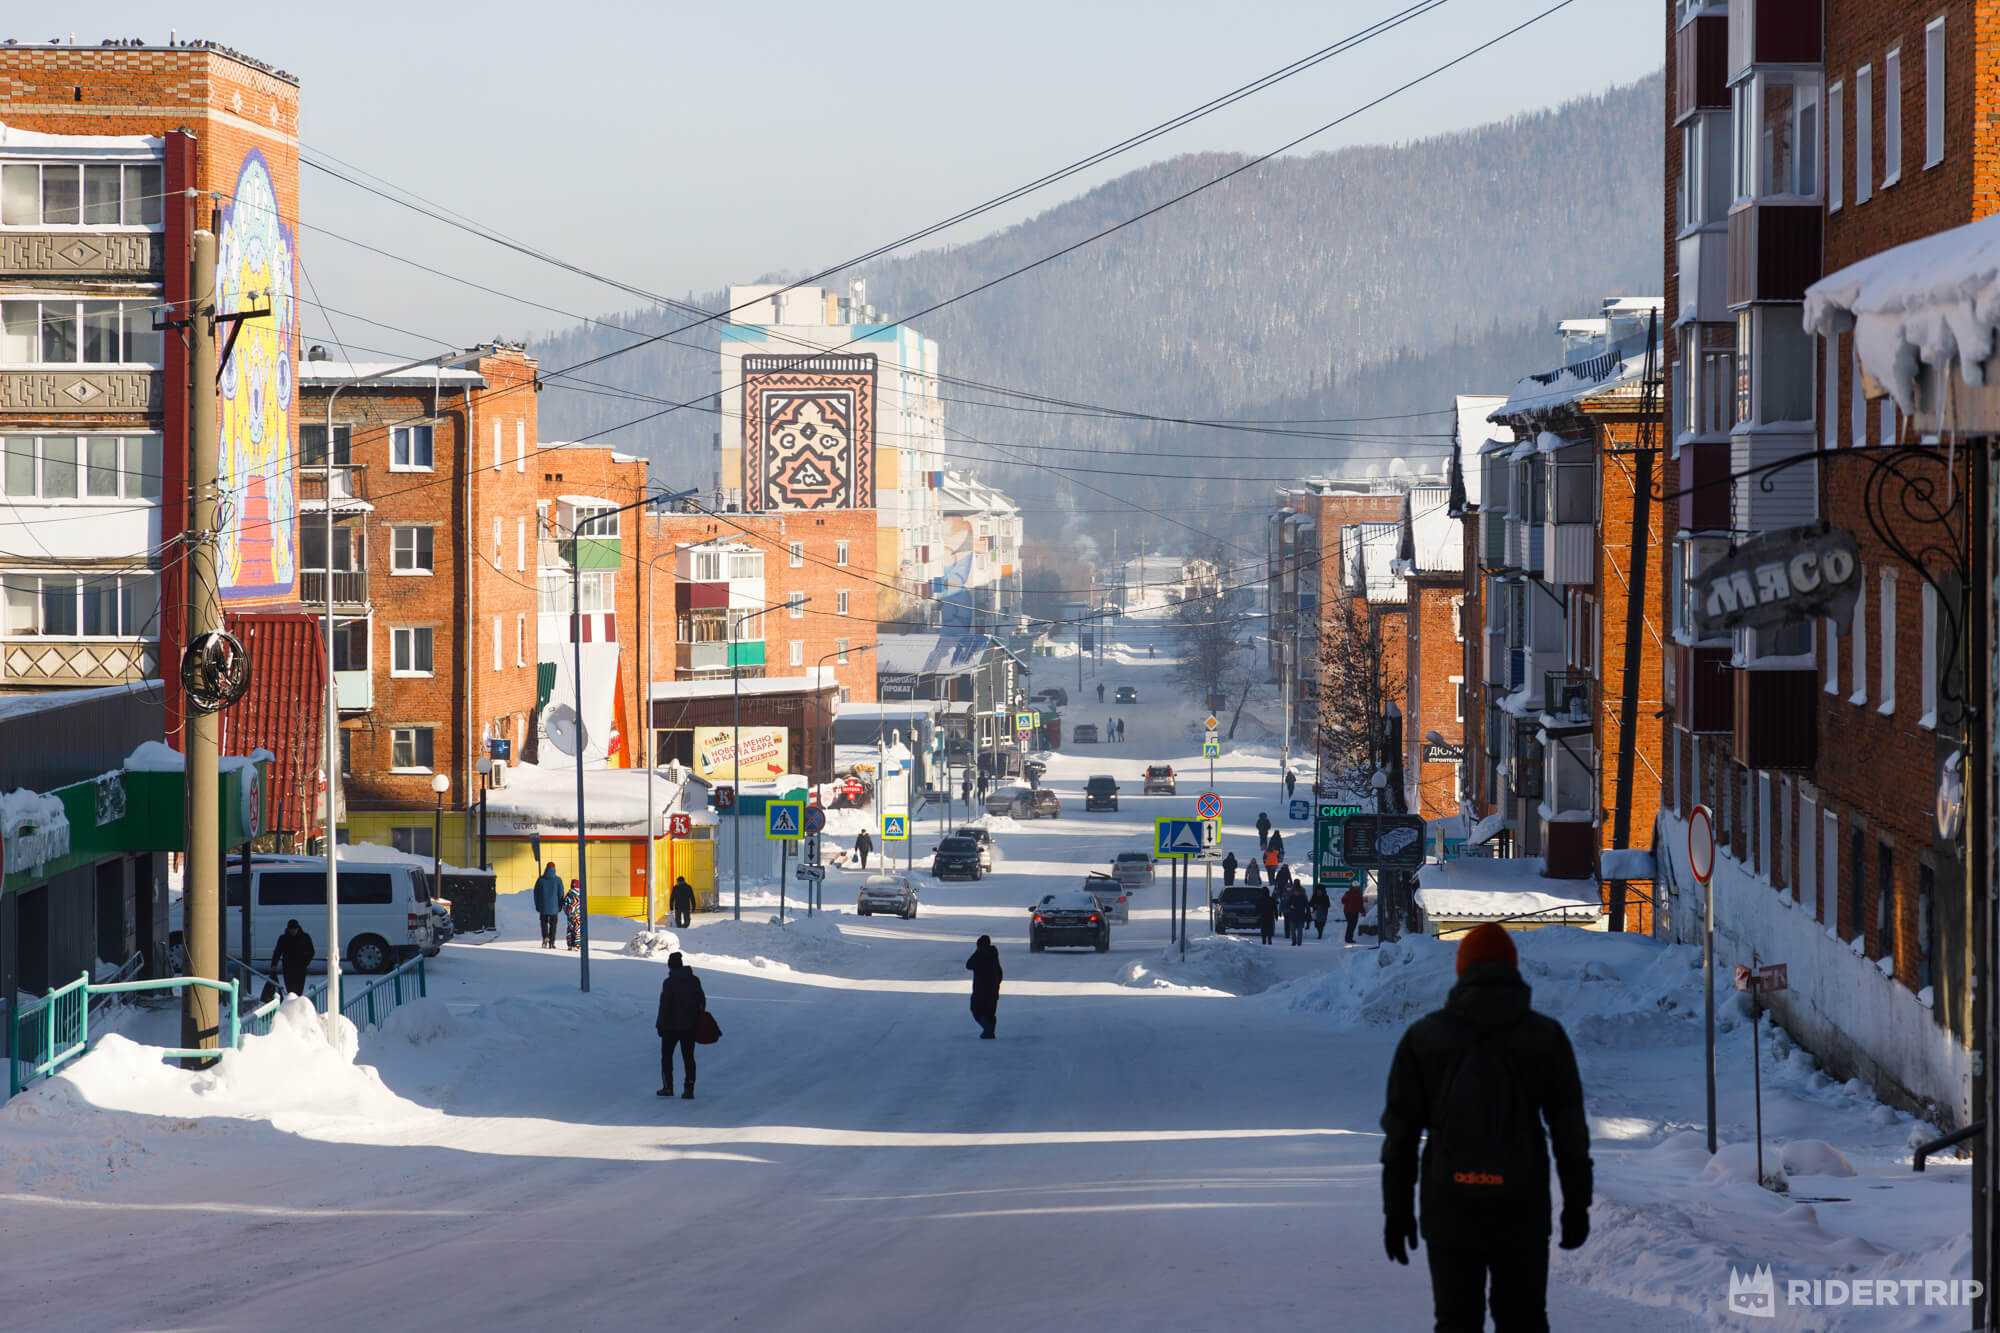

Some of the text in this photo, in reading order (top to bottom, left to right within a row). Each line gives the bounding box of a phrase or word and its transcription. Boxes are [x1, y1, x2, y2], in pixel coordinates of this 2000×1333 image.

[1707, 550, 1854, 617] МЯСО
[743, 735, 771, 749] МЕНЮ
[1454, 1171, 1504, 1184] adidas
